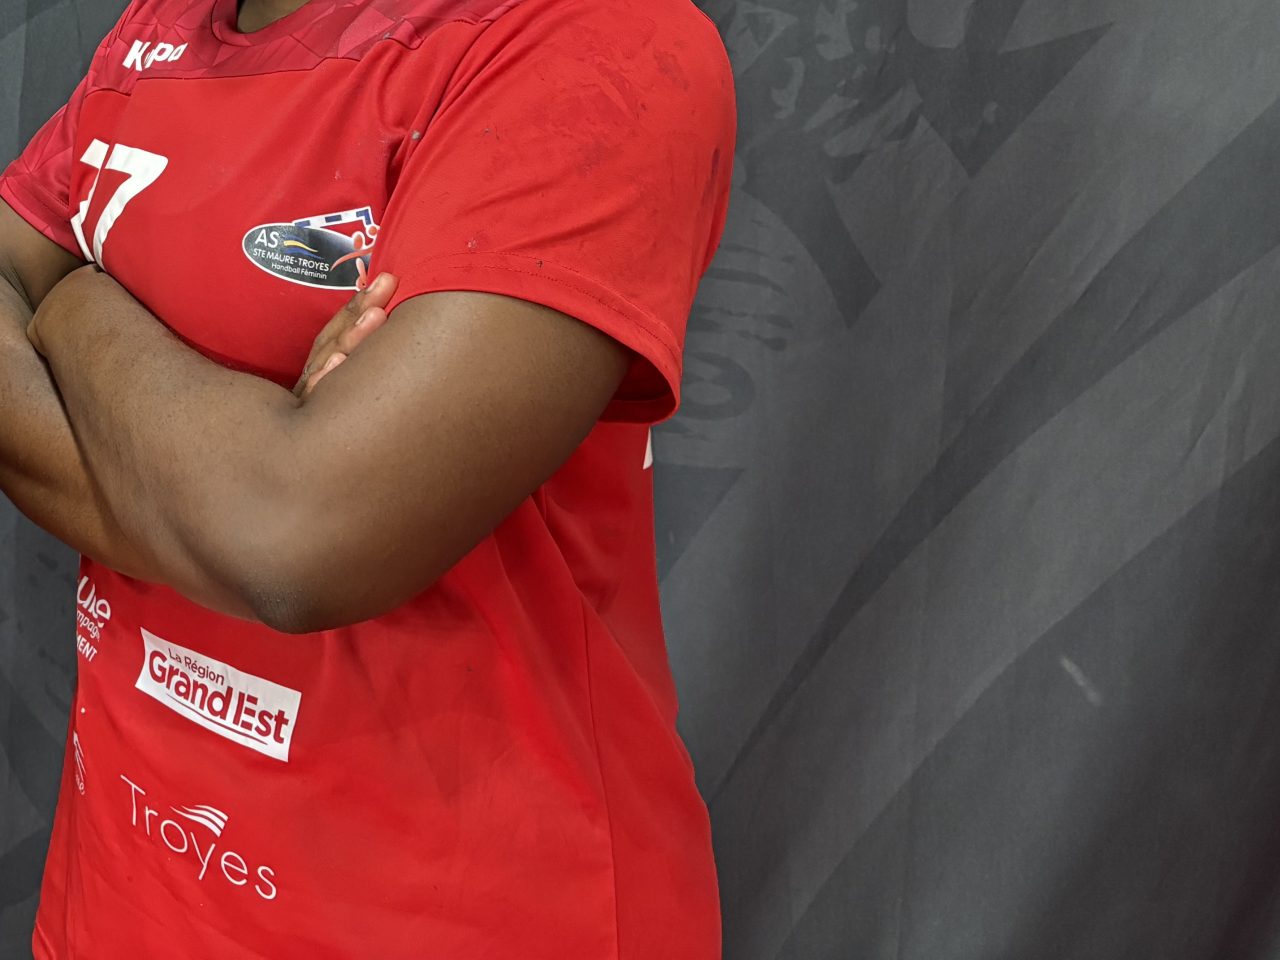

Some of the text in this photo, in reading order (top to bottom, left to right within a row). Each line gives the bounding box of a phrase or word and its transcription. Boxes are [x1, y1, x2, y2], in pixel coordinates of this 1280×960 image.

[254, 229, 280, 248] AS
[253, 248, 266, 258] STE
[271, 262, 301, 275] Handball
[168, 648, 225, 686] La Région
[148, 650, 289, 744] Grand Est
[120, 774, 278, 900] Troyes
